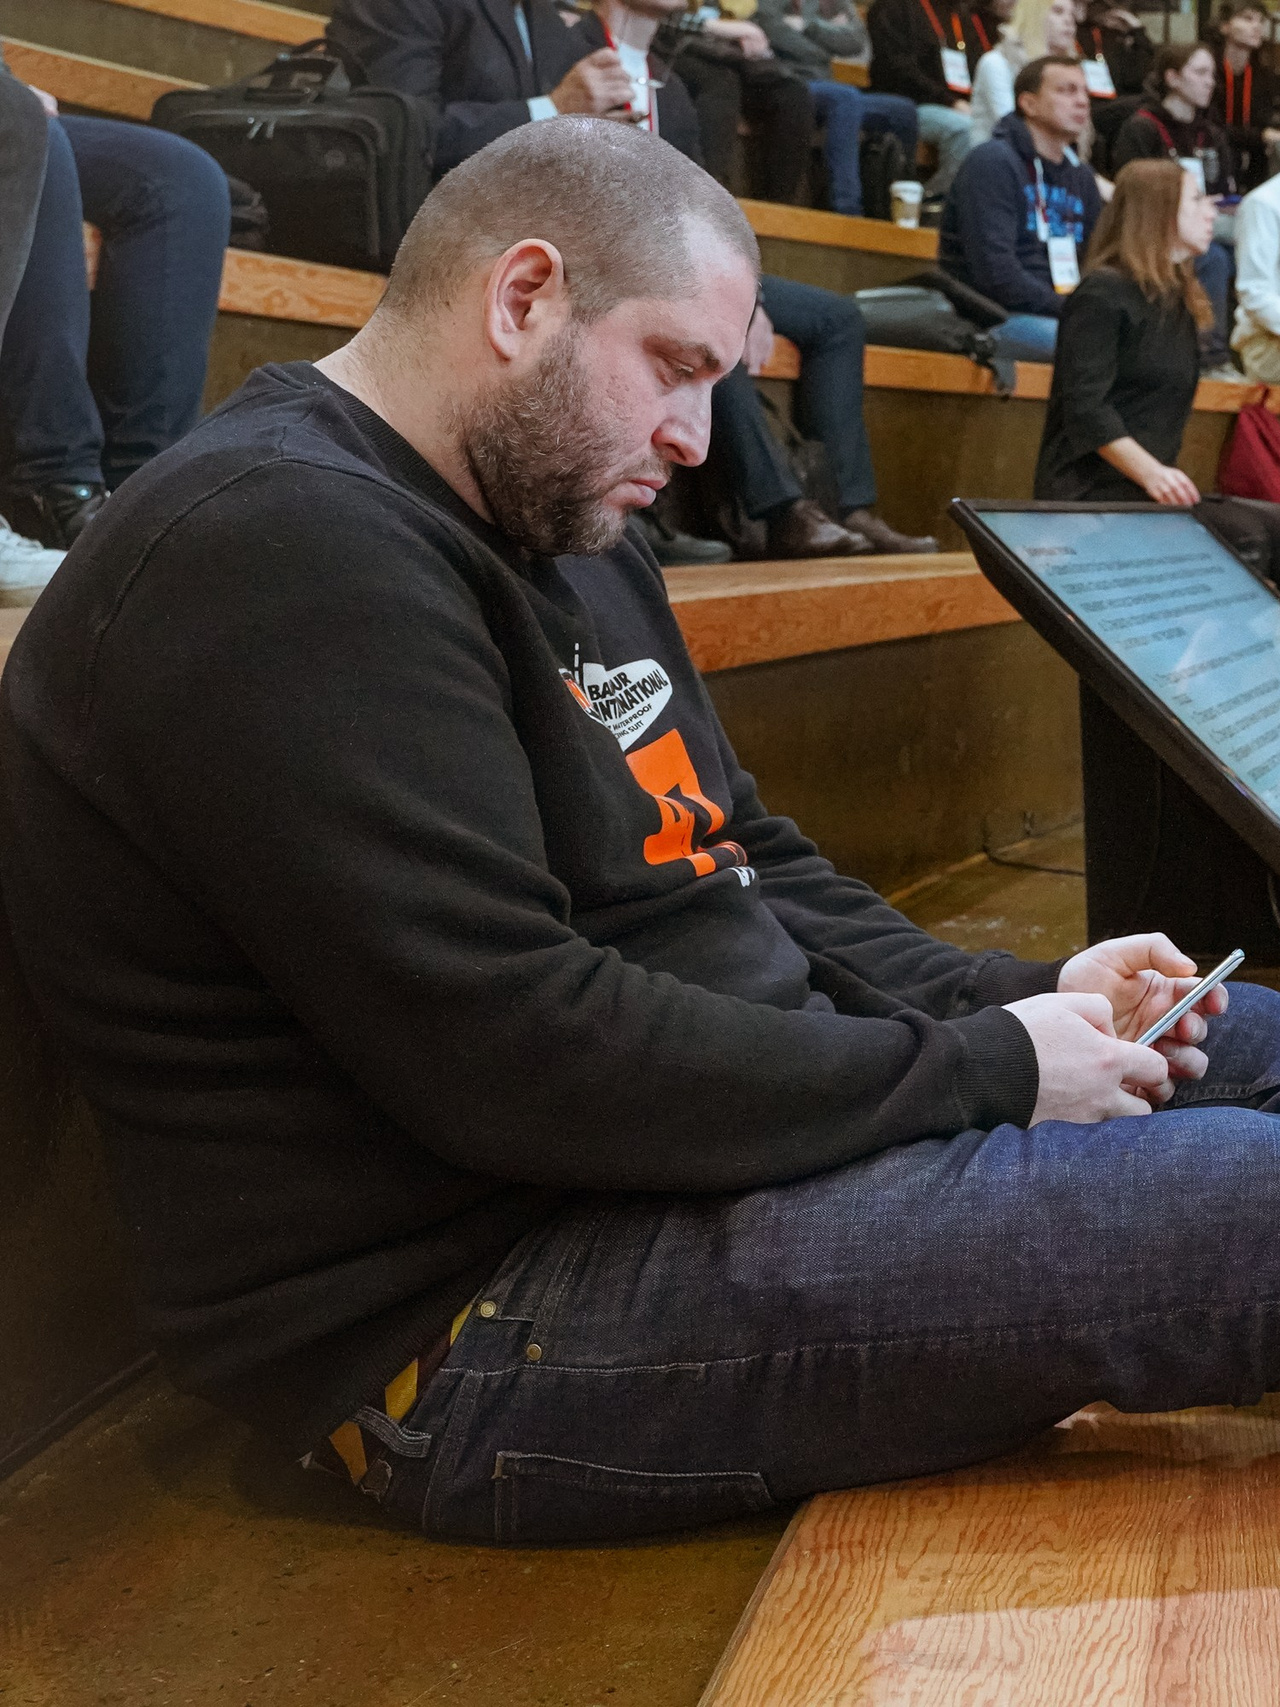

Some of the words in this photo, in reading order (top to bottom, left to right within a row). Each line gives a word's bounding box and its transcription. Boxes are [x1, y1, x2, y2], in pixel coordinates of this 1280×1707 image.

[588, 672, 632, 700] BAUR
[591, 669, 669, 721] INTNATIONAL
[628, 720, 644, 732] SUIT
